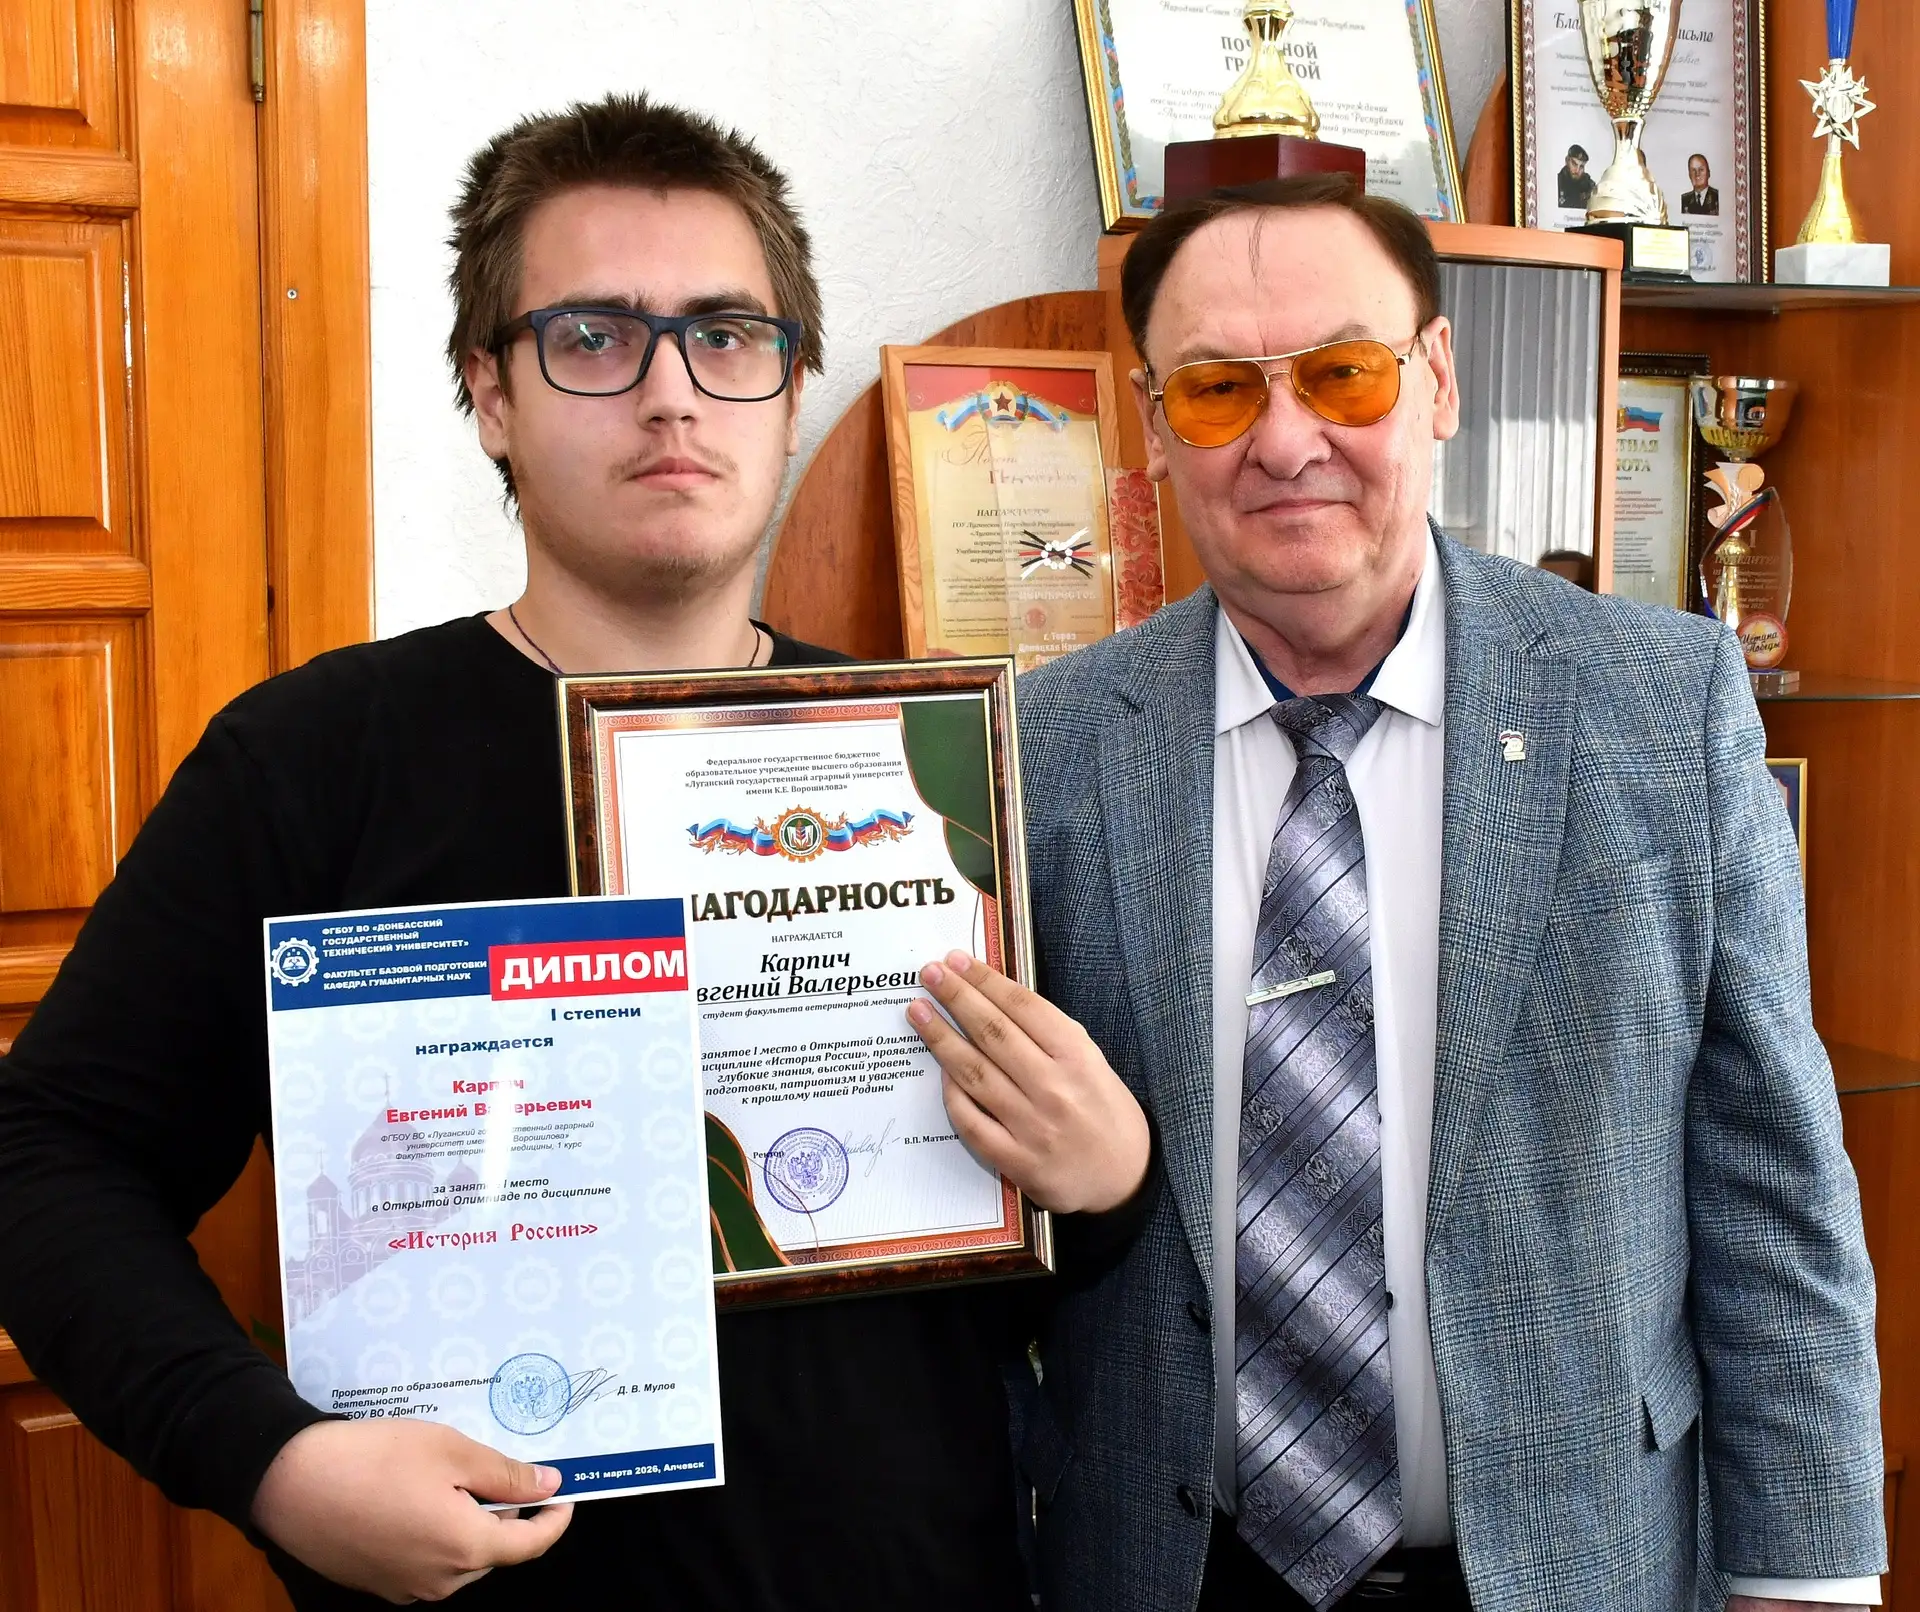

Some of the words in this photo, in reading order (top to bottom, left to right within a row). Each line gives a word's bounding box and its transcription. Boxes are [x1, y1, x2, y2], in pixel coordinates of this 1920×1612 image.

[706, 756, 762, 767] Федеральное
[764, 753, 833, 765] государственное
[835, 750, 881, 761] бюджетное
[685, 767, 758, 778] образовательное
[759, 764, 810, 775] учреждение
[812, 762, 848, 771] высшего
[850, 760, 902, 770] образования
[685, 778, 735, 789] «Луганский
[736, 774, 808, 787] государственный
[810, 771, 850, 783] аграрный
[852, 769, 904, 781] университет
[746, 786, 773, 796] имени
[774, 785, 789, 794] К.Е.
[791, 783, 848, 793] Ворошилова»
[322, 925, 354, 935] ФГБОУ
[356, 924, 370, 932] ВО
[373, 919, 443, 931] «ДОНБАССКИЙ
[323, 931, 419, 945] ГОСУДАРСТВЕННЫЙ
[771, 931, 843, 943] НАГРАЖДАЕТСЯ
[323, 944, 393, 957] ТЕХНИЧЕСКИЙ
[395, 939, 470, 951] УНИВЕРСИТЕТ»
[323, 968, 377, 979] ФАКУЛЬТЕТ
[379, 964, 423, 974] БАЗОВОЙ
[425, 960, 487, 973] ПОДГОТОВКИ
[501, 950, 685, 991] ДИПЛОМ
[760, 952, 850, 976] Карпич
[323, 980, 367, 991] КАФЕДРА
[369, 974, 445, 986] ГУМАНИТАРНЫХ
[447, 972, 471, 981] НАУК
[697, 976, 781, 1002] вгений
[788, 970, 921, 996] Валерьеви
[551, 1008, 556, 1022] I
[563, 1005, 641, 1022] степени
[702, 1008, 743, 1020] студент
[745, 1004, 803, 1018] факультета
[805, 998, 869, 1011] ветеринарной
[415, 1035, 554, 1057] награждается
[701, 1049, 751, 1060] занятое
[760, 1043, 798, 1055] место
[800, 1044, 807, 1052] в
[809, 1036, 873, 1051] Открытой
[875, 1034, 924, 1046] Олимпи
[702, 1060, 762, 1073] исциплине
[765, 1053, 821, 1066] «История
[824, 1050, 870, 1063] России»,
[872, 1045, 931, 1059] проявленн
[717, 1071, 769, 1084] глубокие
[772, 1066, 815, 1078] знания,
[817, 1061, 866, 1074] высокий
[867, 1058, 912, 1072] уровень
[453, 1080, 524, 1095] Карпч
[705, 1081, 778, 1096] подготовки,
[780, 1075, 856, 1091] патриотизм
[859, 1075, 866, 1083] и
[868, 1069, 925, 1083] уважение
[742, 1096, 749, 1104] к
[751, 1090, 810, 1105] прошлому
[813, 1087, 849, 1098] нашей
[852, 1084, 894, 1095] Родины
[387, 1104, 468, 1123] Евгений
[475, 1099, 592, 1117] Верьевич
[381, 1132, 411, 1142] ФГБОУ
[412, 1131, 425, 1140] ВО
[428, 1128, 476, 1140] «Луганский
[554, 1120, 595, 1131] аграрный
[904, 1136, 921, 1145] В.П.
[396, 1150, 445, 1161] Факультет
[564, 1140, 583, 1149] курс
[407, 1139, 465, 1151] университет
[513, 1132, 570, 1143] Ворошилова»
[753, 1149, 785, 1160] Ректор
[433, 1185, 446, 1194] за
[510, 1178, 550, 1188] место
[371, 1204, 379, 1212] в
[382, 1195, 450, 1211] Открытой
[523, 1191, 538, 1200] по
[541, 1186, 611, 1199] дисциплине
[388, 1228, 497, 1250] «История
[510, 1222, 598, 1242] России»
[332, 1386, 388, 1398] Проректор
[406, 1375, 501, 1392] образовательной
[618, 1386, 628, 1395] Д.
[631, 1384, 640, 1393] В.
[643, 1381, 676, 1394] Мулов
[332, 1396, 409, 1409] деятельности
[343, 1410, 368, 1420] БОУ
[370, 1408, 384, 1418] ВО
[388, 1404, 438, 1417] «ДонГТУ»
[574, 1471, 601, 1481] 30-31
[603, 1468, 632, 1480] марта
[635, 1464, 661, 1477] 2026,
[663, 1460, 705, 1473] Алчевск
